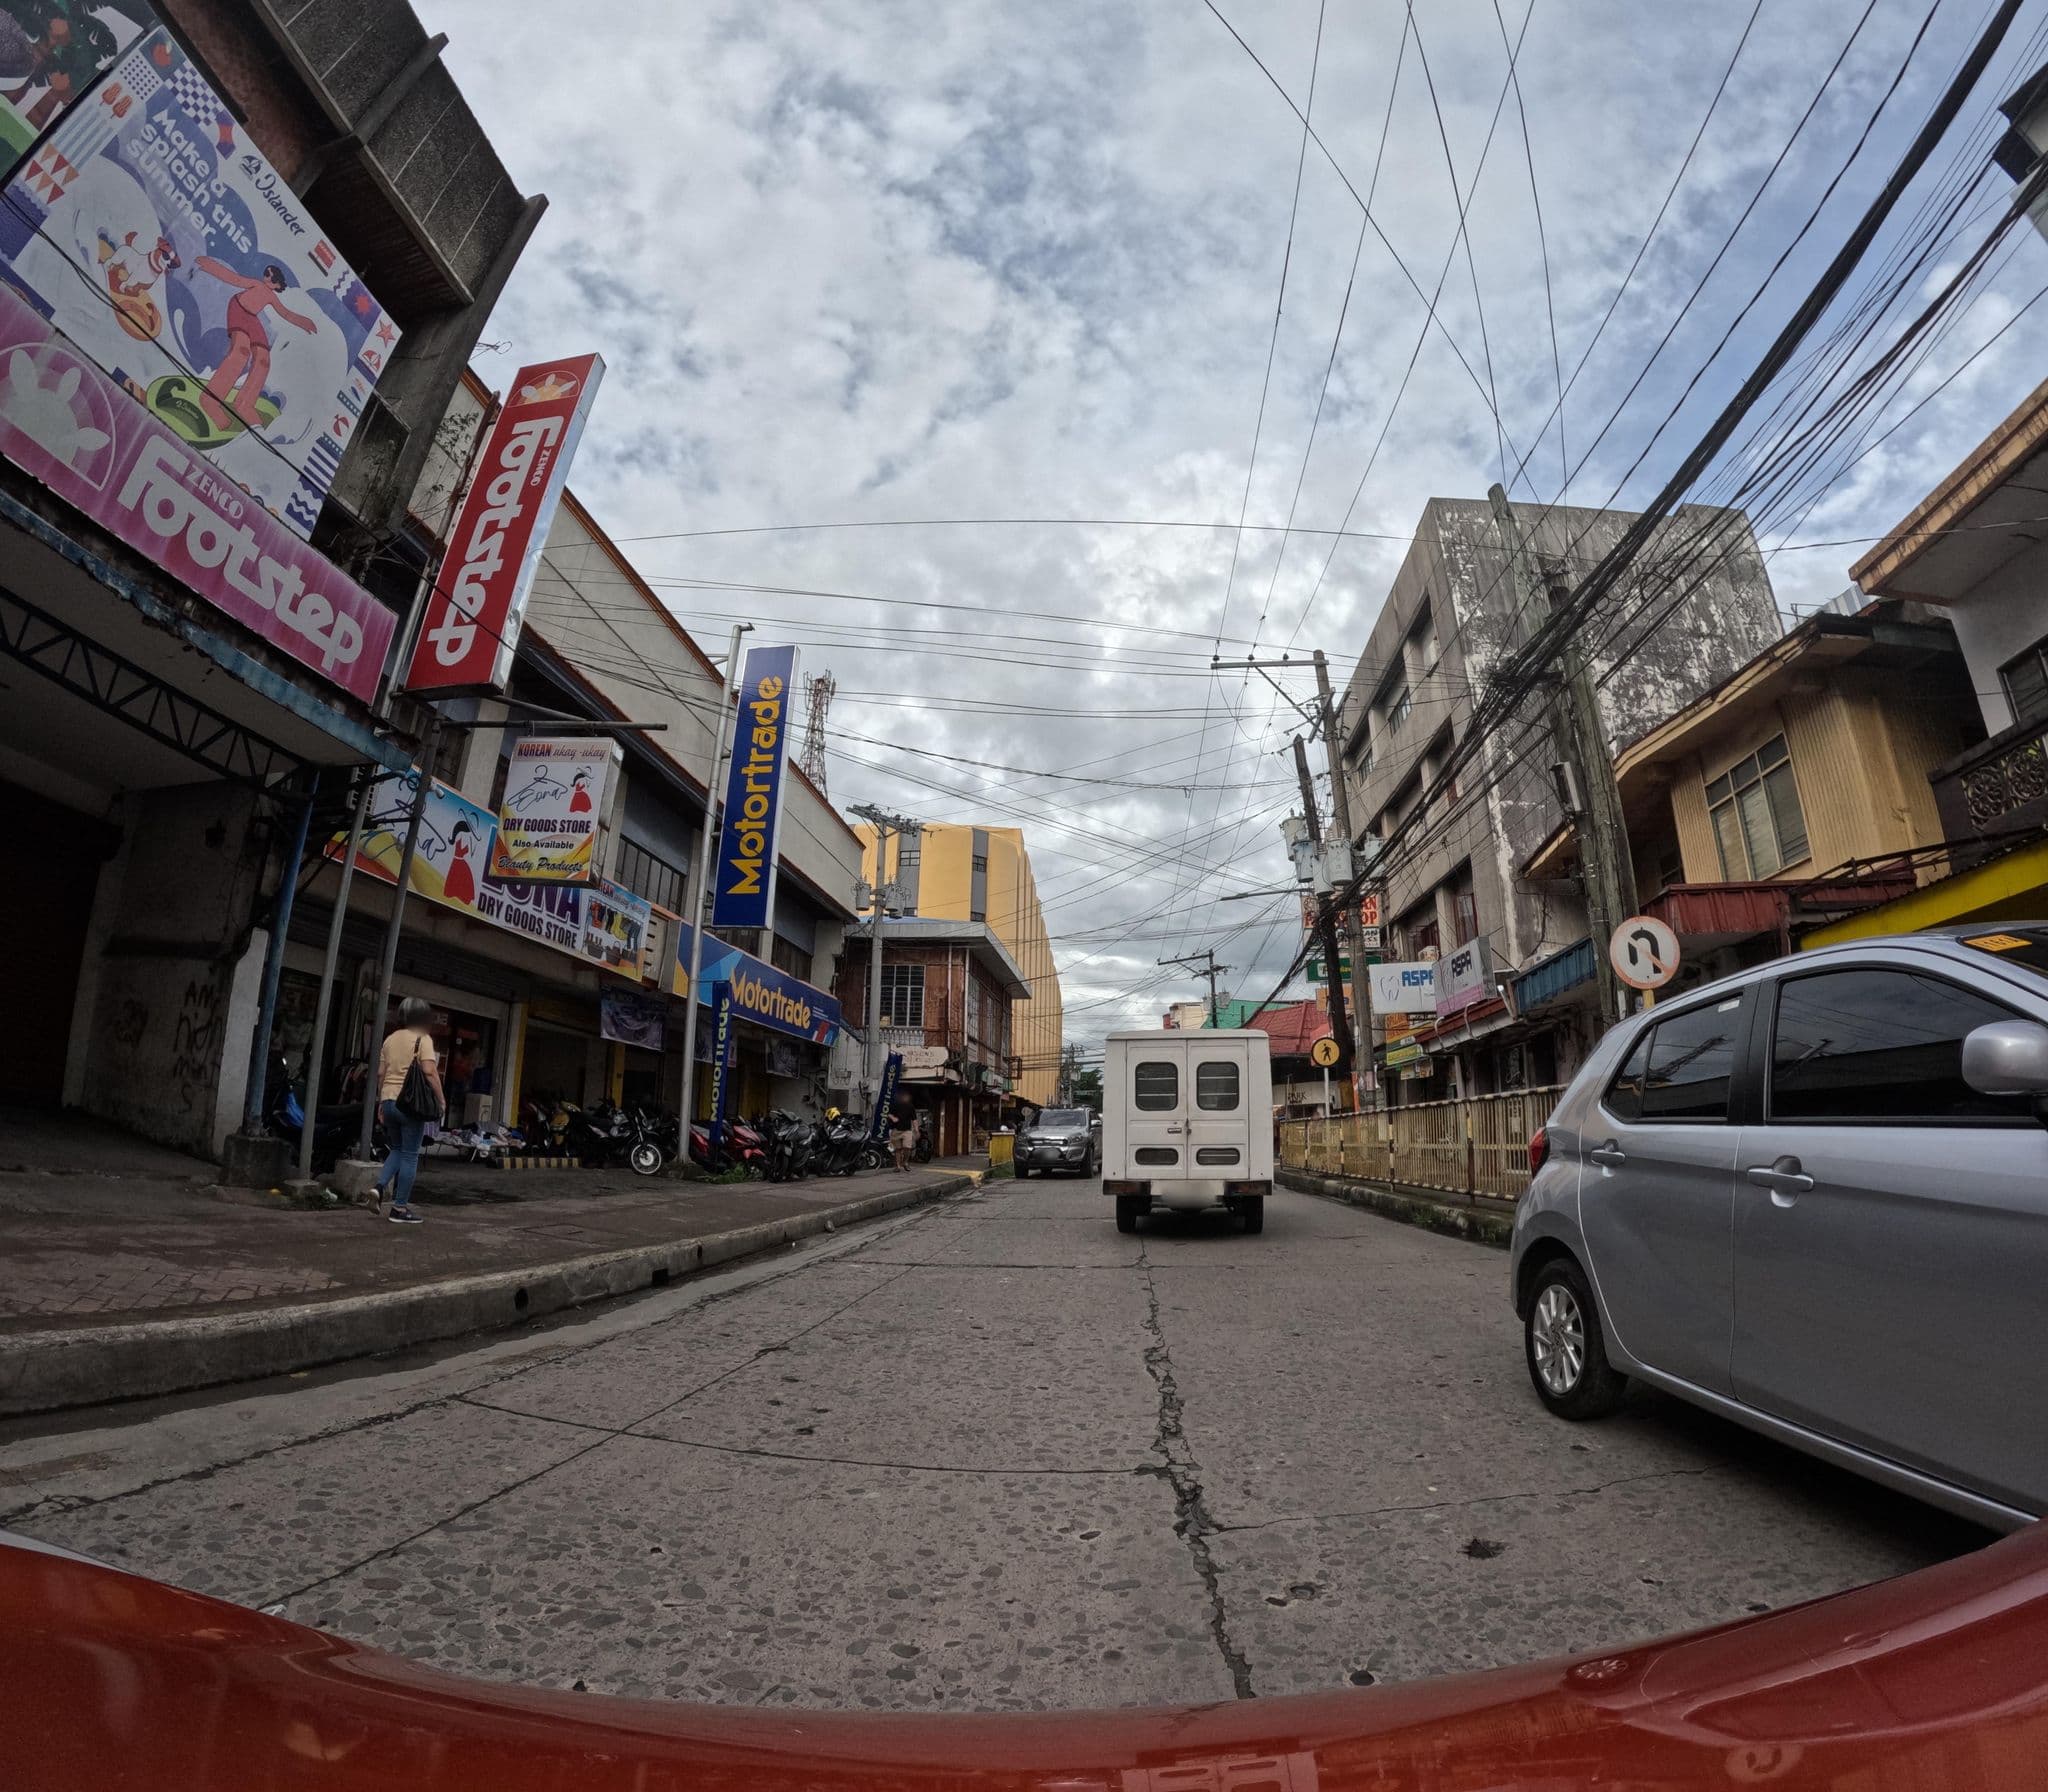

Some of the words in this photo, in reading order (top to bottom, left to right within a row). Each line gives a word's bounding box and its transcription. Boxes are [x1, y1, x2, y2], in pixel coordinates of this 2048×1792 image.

[152, 109, 210, 178] Make
[210, 178, 229, 199] a
[127, 139, 217, 247] summer.
[140, 123, 211, 207] splash
[211, 203, 252, 254] this
[255, 173, 305, 236] Islander
[185, 465, 245, 519] ZENCO
[117, 434, 363, 672] Footstep
[427, 415, 564, 667] Footstep
[517, 743, 552, 757] KOREAN
[725, 675, 783, 894] Motortrade
[503, 818, 524, 832] DRY
[524, 819, 557, 832] GOODS
[559, 820, 592, 834] STORE
[512, 839, 532, 848] Also
[534, 840, 574, 850] Available
[498, 856, 533, 872] Beauty
[536, 857, 583, 873] Products
[477, 892, 505, 919] DRY
[504, 903, 544, 936] GOODS
[544, 924, 578, 949] STORE
[730, 968, 812, 1030] Motortrade
